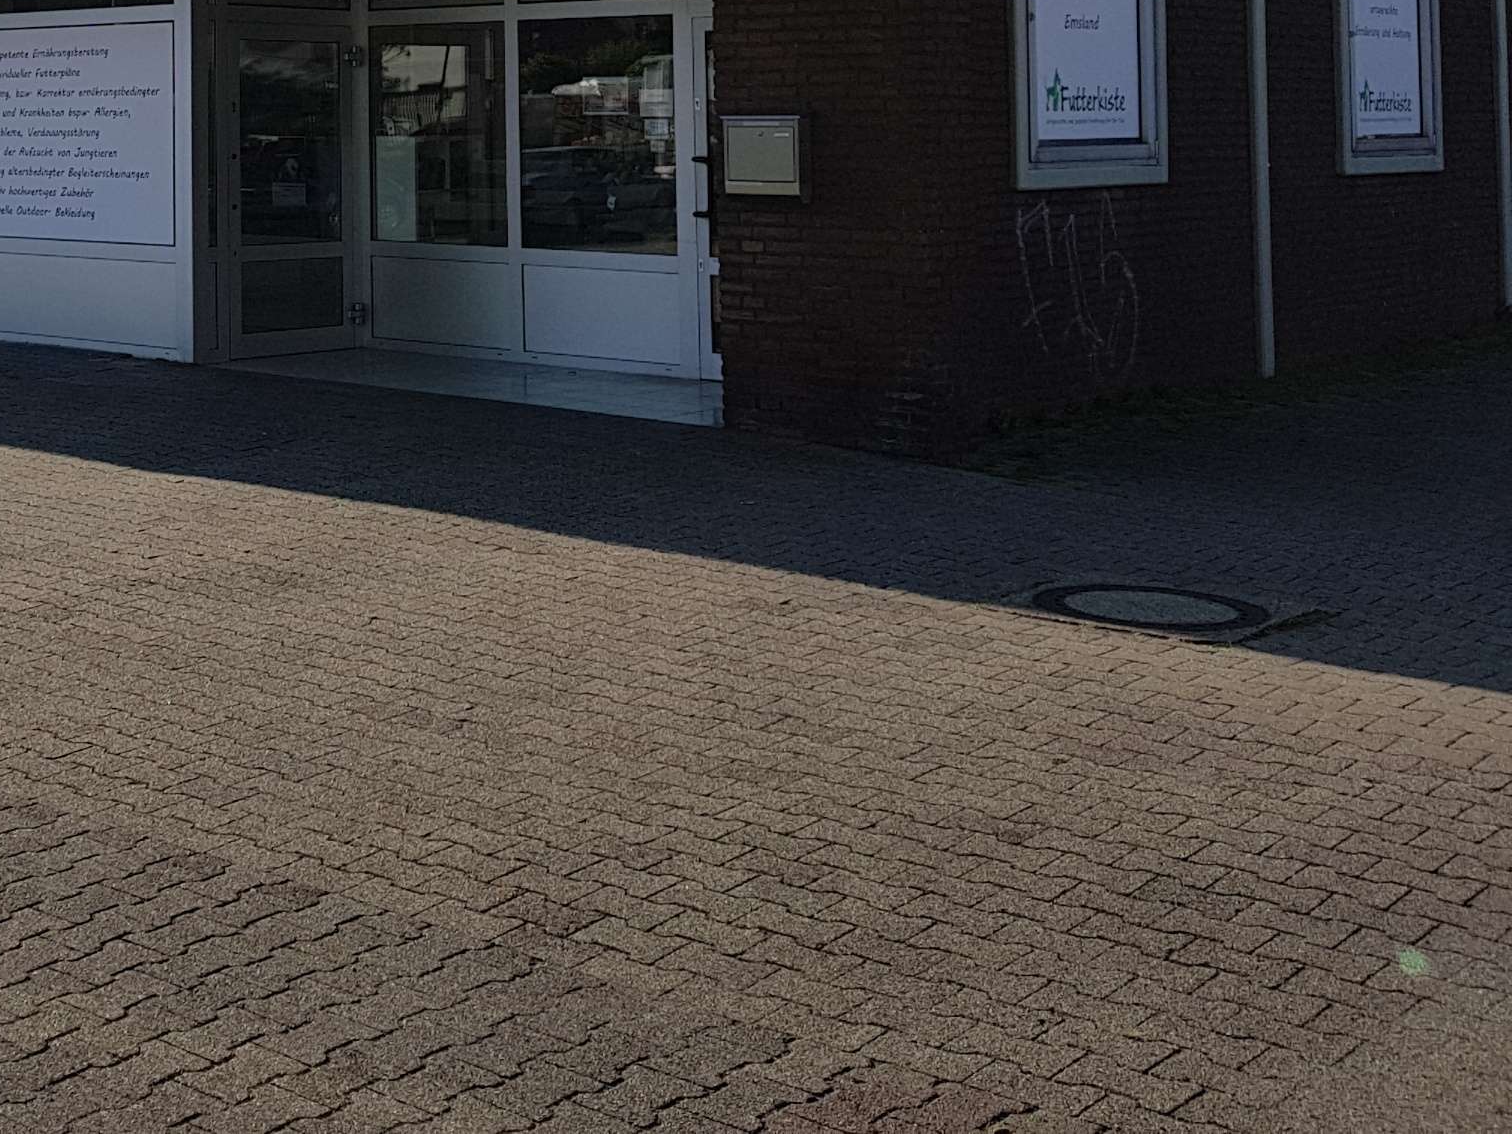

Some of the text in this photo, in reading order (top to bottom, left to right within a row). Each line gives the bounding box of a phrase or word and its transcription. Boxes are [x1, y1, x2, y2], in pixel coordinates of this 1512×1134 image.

[1064, 14, 1100, 31] Emsland
[32, 47, 109, 60] Ernährungsberatung
[37, 89, 75, 97] Korrektur
[79, 87, 160, 99] ernährungsbedingter
[1060, 85, 1126, 112] Futterkiste
[1368, 90, 1412, 113] Futterkiste
[3, 108, 16, 117] und
[19, 108, 65, 117] Krankheiten
[4, 148, 16, 157] der
[19, 147, 53, 157] Aufzucht
[74, 147, 117, 159] Jungtieren
[68, 168, 150, 181] Begleiterscheinungen
[60, 187, 95, 198] Zubehör
[55, 206, 96, 220] Bekleidung
